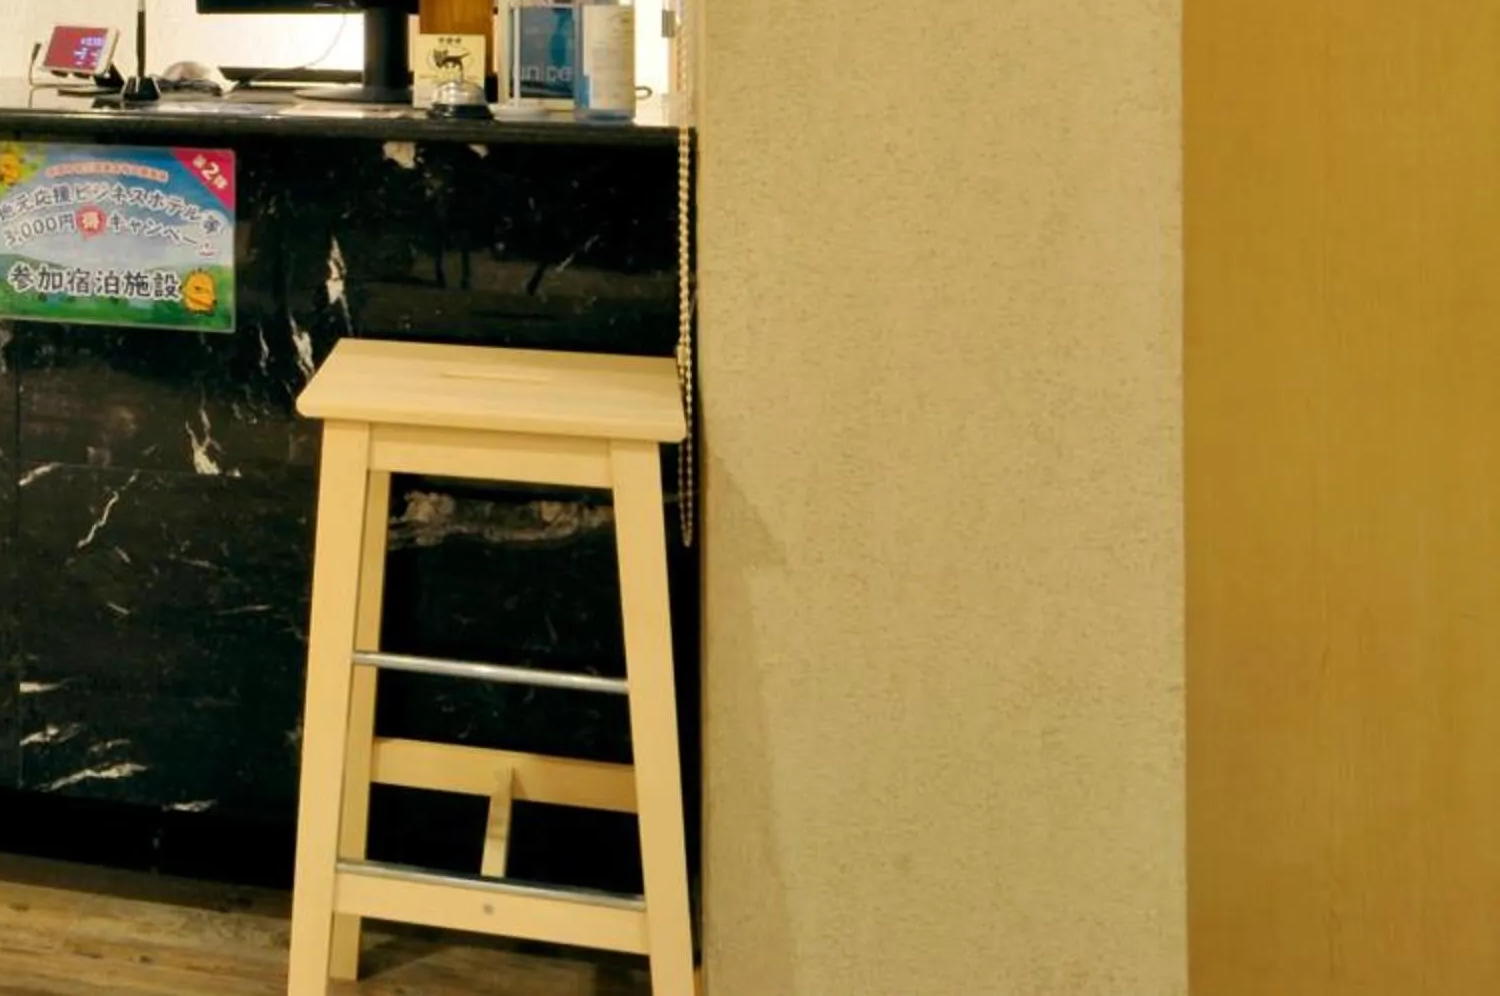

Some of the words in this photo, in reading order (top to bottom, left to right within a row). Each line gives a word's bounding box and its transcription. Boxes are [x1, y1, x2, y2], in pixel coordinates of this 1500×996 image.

[11, 265, 181, 298] 参加宿泊施設
